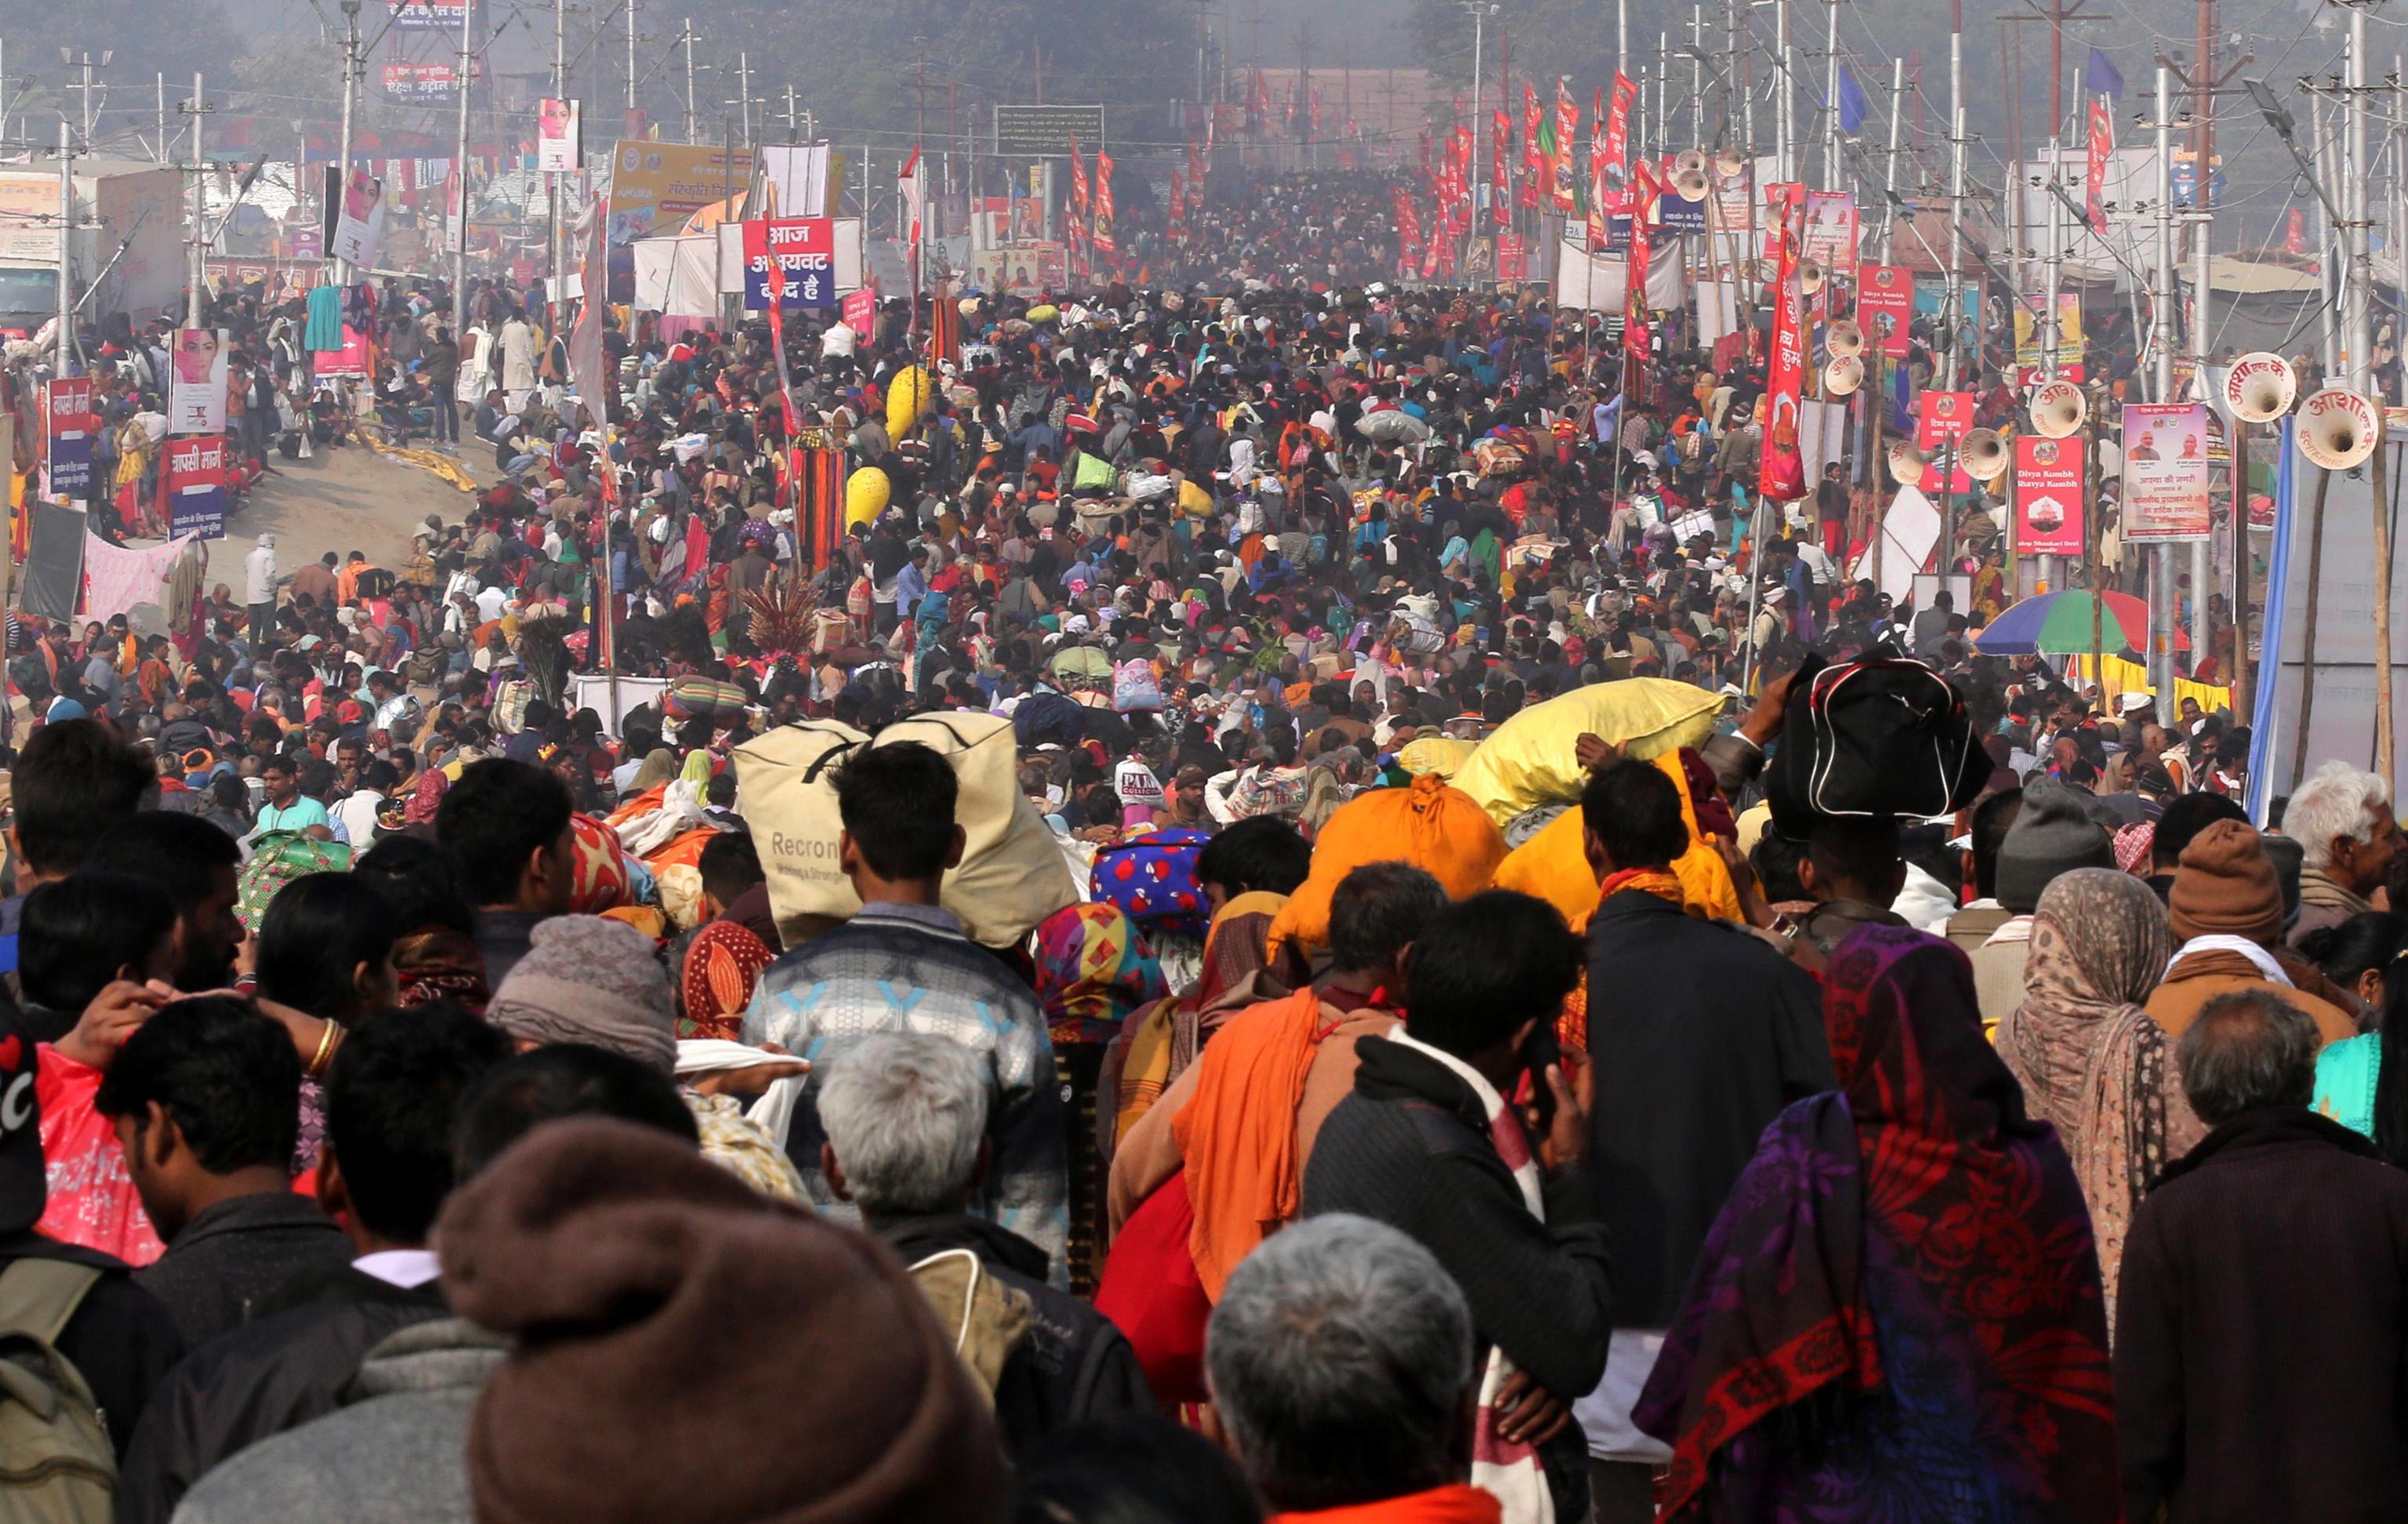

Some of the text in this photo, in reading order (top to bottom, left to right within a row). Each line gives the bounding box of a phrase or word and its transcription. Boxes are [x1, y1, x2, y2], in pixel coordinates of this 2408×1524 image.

[770, 226, 810, 244] आज
[803, 273, 820, 300] है
[2039, 369, 2072, 379] RPA
[2229, 361, 2251, 405] आशा
[54, 385, 89, 415] वापसी मार्ग
[2040, 384, 2079, 406] आशा
[2309, 391, 2365, 416] आशा
[172, 441, 222, 474] वापसी मार्ग
[2018, 470, 2041, 479] Divya
[2139, 476, 2162, 485] आस्था
[2164, 474, 2174, 484] की
[772, 831, 839, 860] Recron
